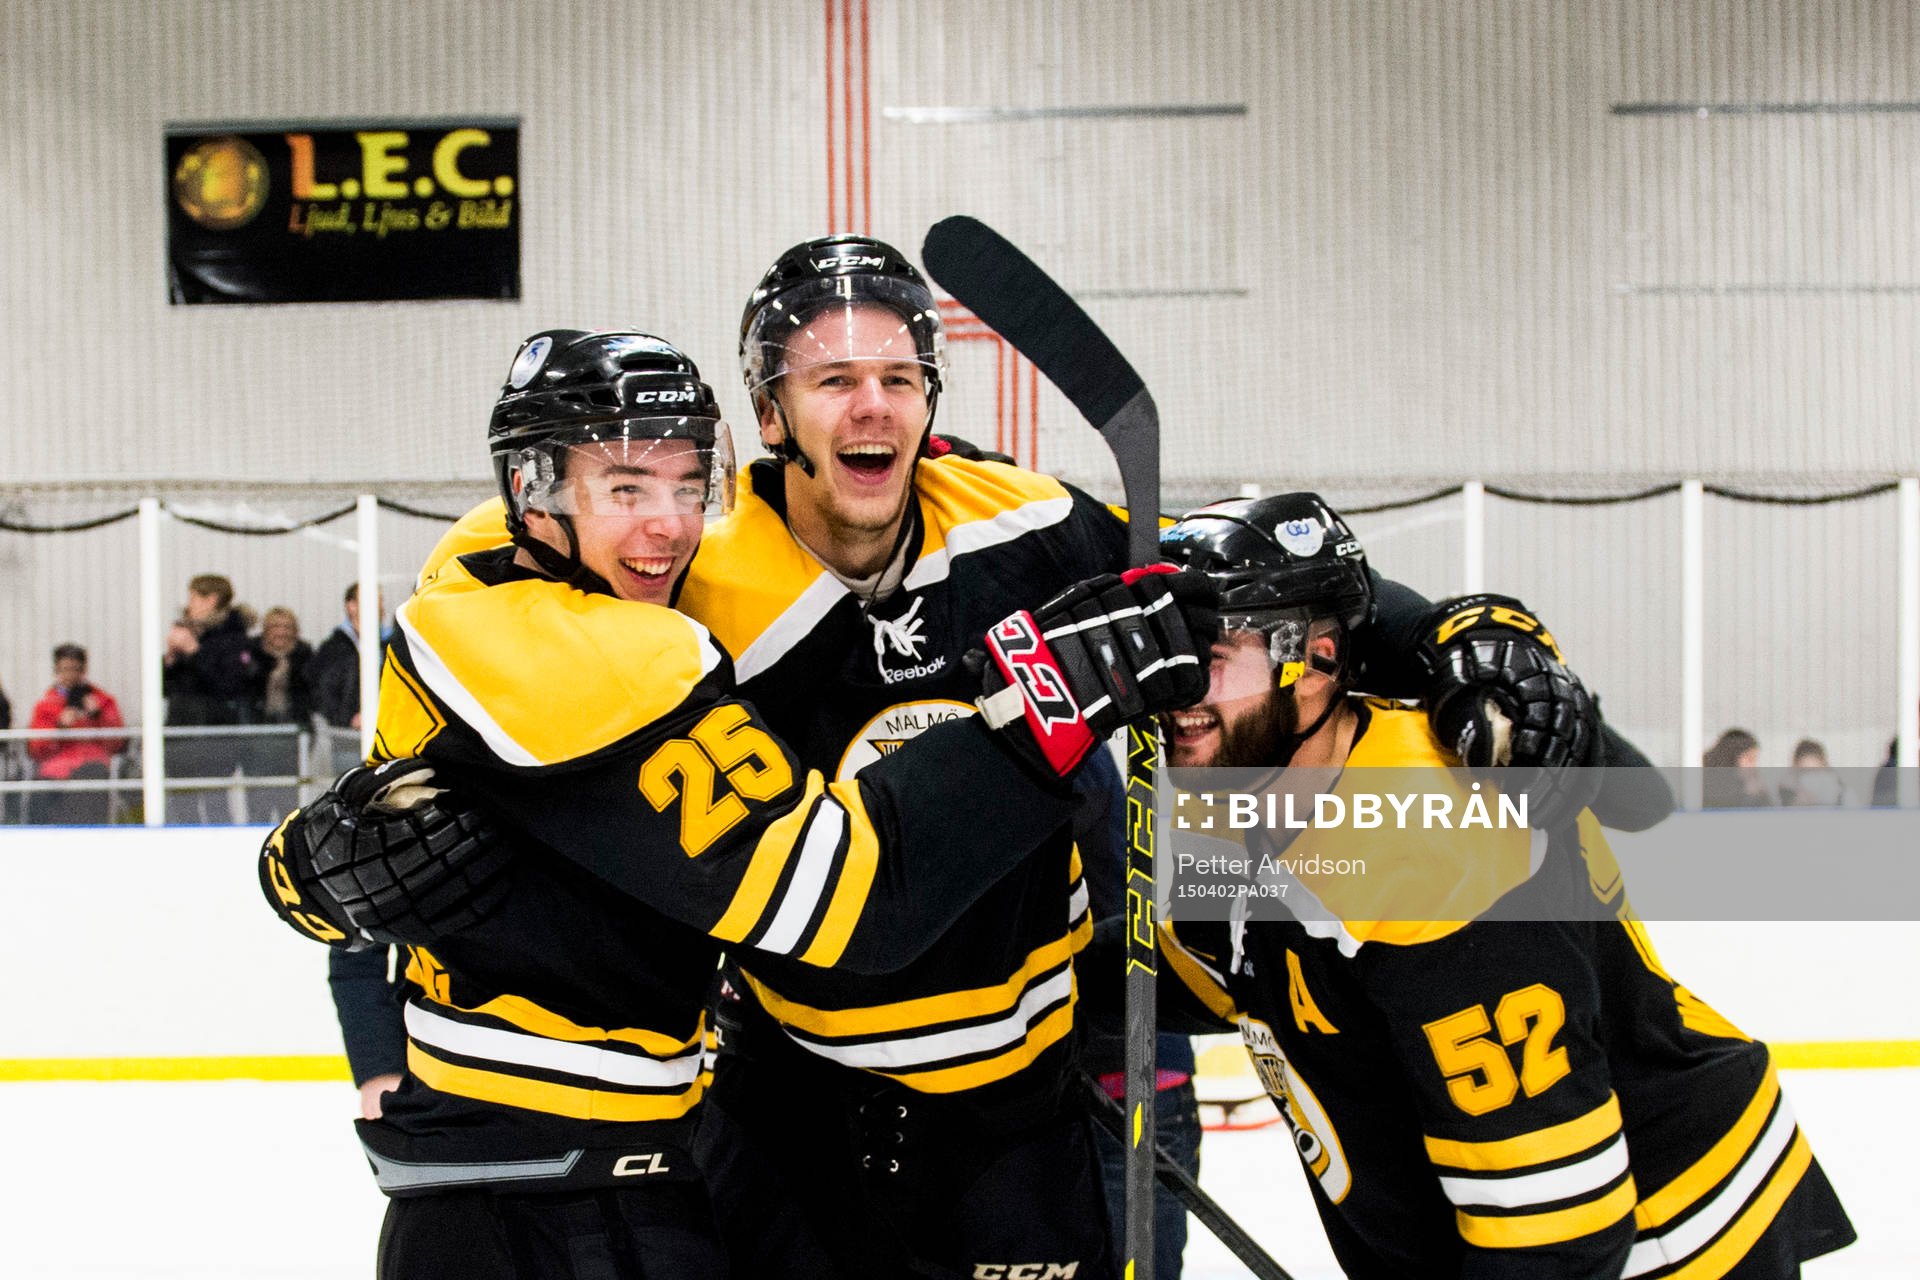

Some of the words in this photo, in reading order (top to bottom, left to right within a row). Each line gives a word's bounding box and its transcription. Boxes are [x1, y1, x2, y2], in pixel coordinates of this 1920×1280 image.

[285, 129, 513, 199] L.E.C.
[424, 201, 453, 230] &
[818, 255, 882, 269] CCM
[884, 655, 947, 685] Reebok
[638, 703, 794, 858] 25
[1286, 948, 1341, 1035] A
[1421, 982, 1572, 1117] 52
[612, 1152, 670, 1177] CL
[972, 1261, 1080, 1280] CCM
